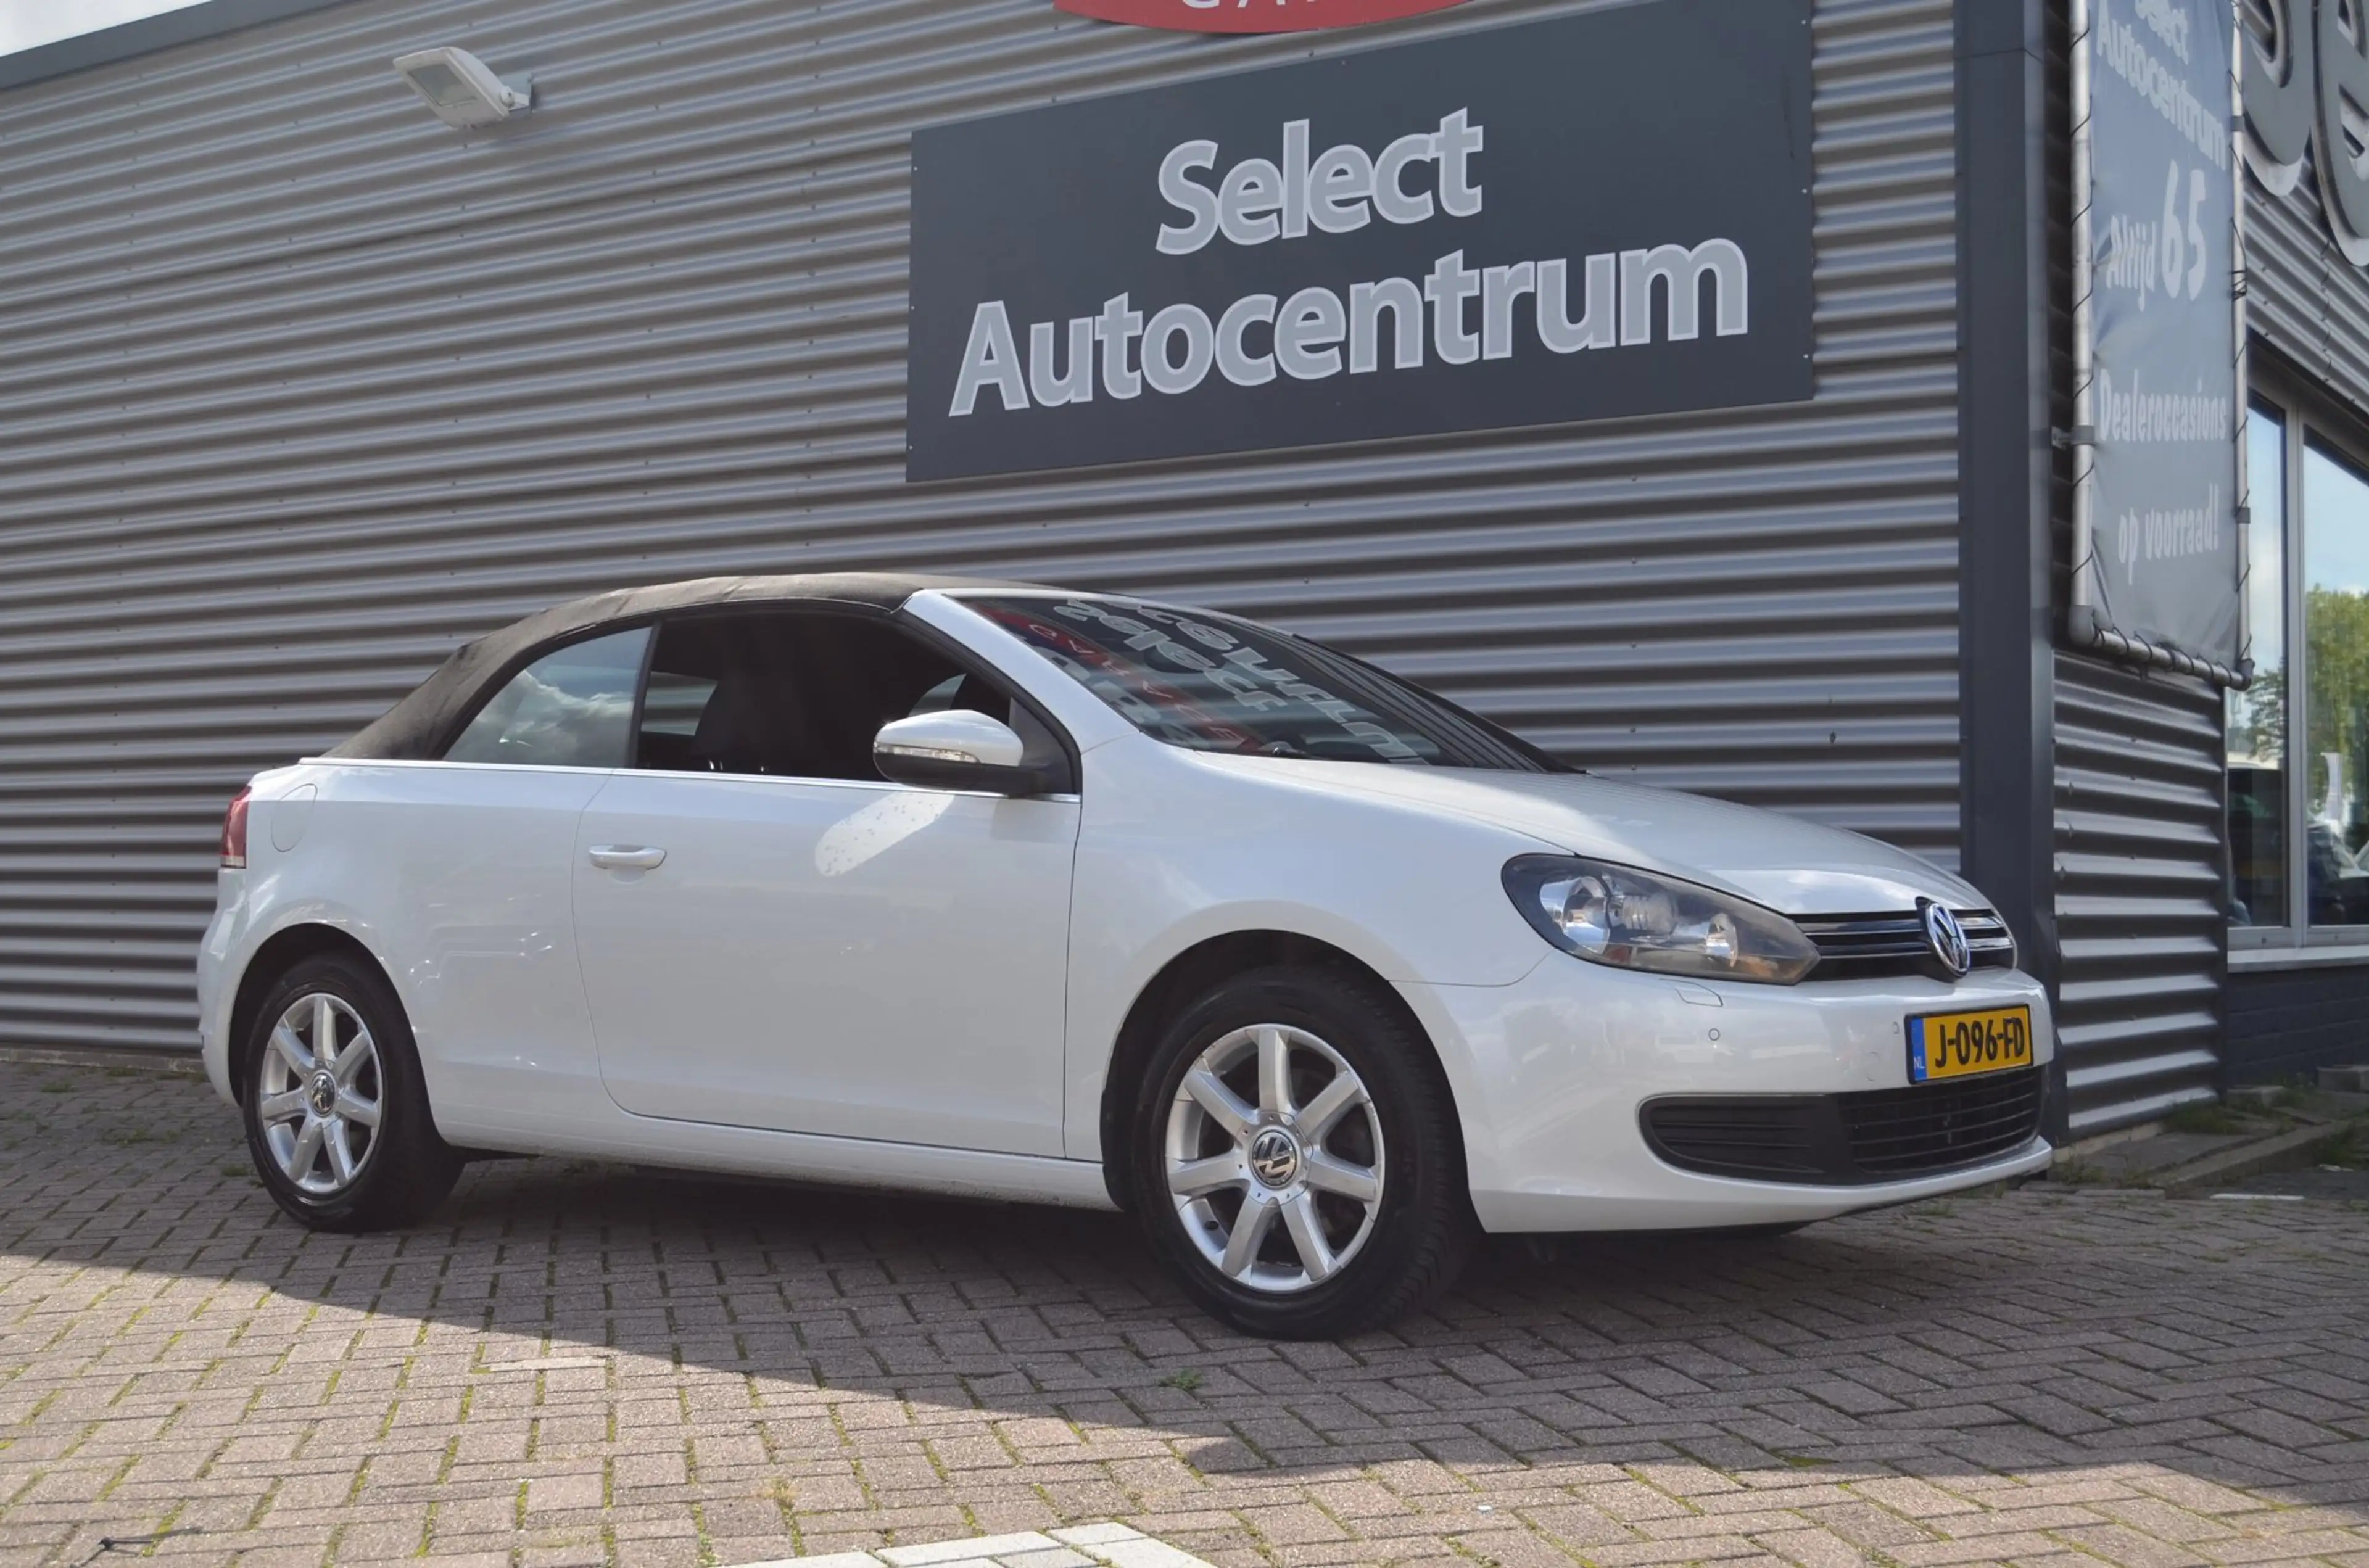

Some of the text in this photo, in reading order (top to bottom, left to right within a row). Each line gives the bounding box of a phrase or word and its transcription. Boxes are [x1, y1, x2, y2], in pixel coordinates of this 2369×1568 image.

[2096, 0, 2226, 171] Autocentrum
[1156, 107, 1484, 255] Select
[2161, 159, 2207, 301] 65
[948, 237, 1748, 417] Autocentrum
[2099, 368, 2226, 443] Dealeroccasions
[2118, 507, 2139, 585] op
[1914, 1057, 1925, 1069] NL
[1935, 1017, 2025, 1068] J-096-FD
